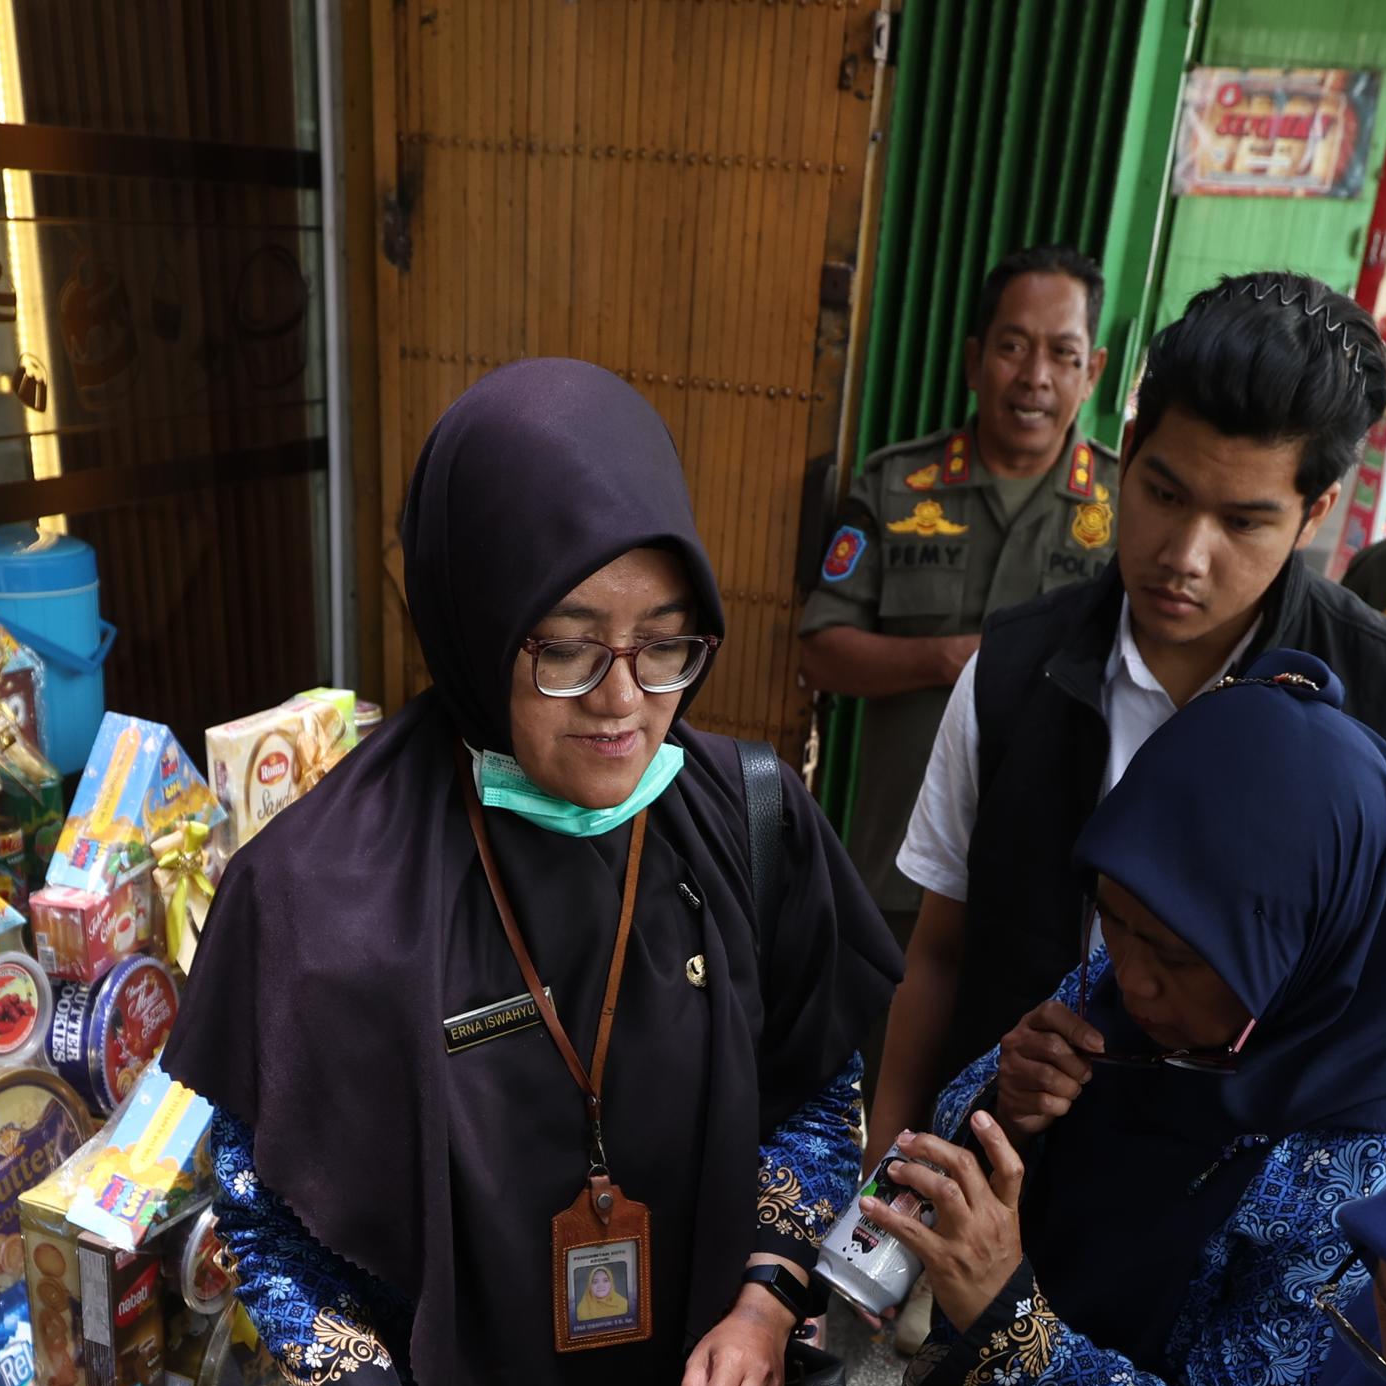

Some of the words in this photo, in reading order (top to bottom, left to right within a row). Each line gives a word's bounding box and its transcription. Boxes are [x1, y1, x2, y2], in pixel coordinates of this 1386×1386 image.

[260, 760, 286, 779] Roma
[450, 1021, 484, 1040] ERNA
[484, 1002, 537, 1032] ISWAHYU
[116, 1285, 149, 1317] nabati
